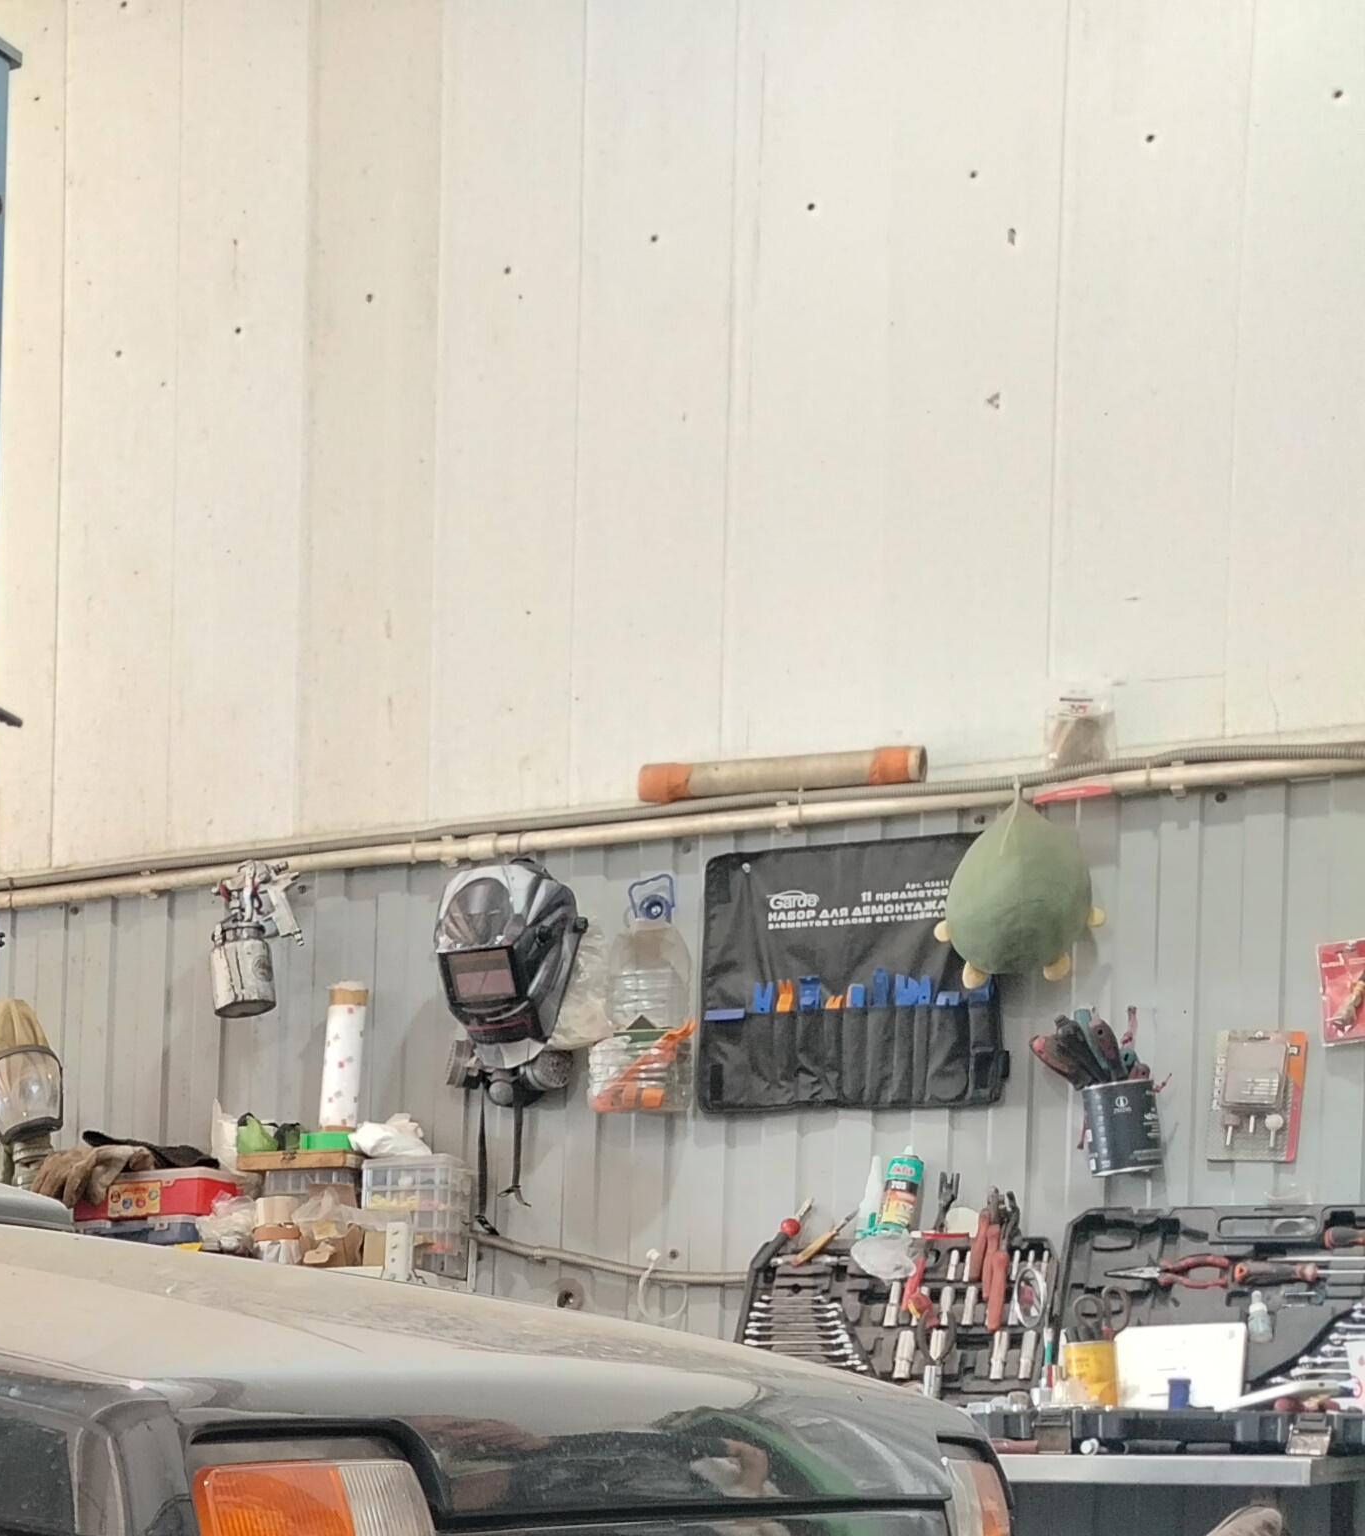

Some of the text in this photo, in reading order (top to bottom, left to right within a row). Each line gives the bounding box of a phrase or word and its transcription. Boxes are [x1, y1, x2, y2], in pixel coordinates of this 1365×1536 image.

[861, 890, 872, 902] 11
[768, 899, 947, 922] НАБОР ДЛЯ ДЕМОНТАЖА
